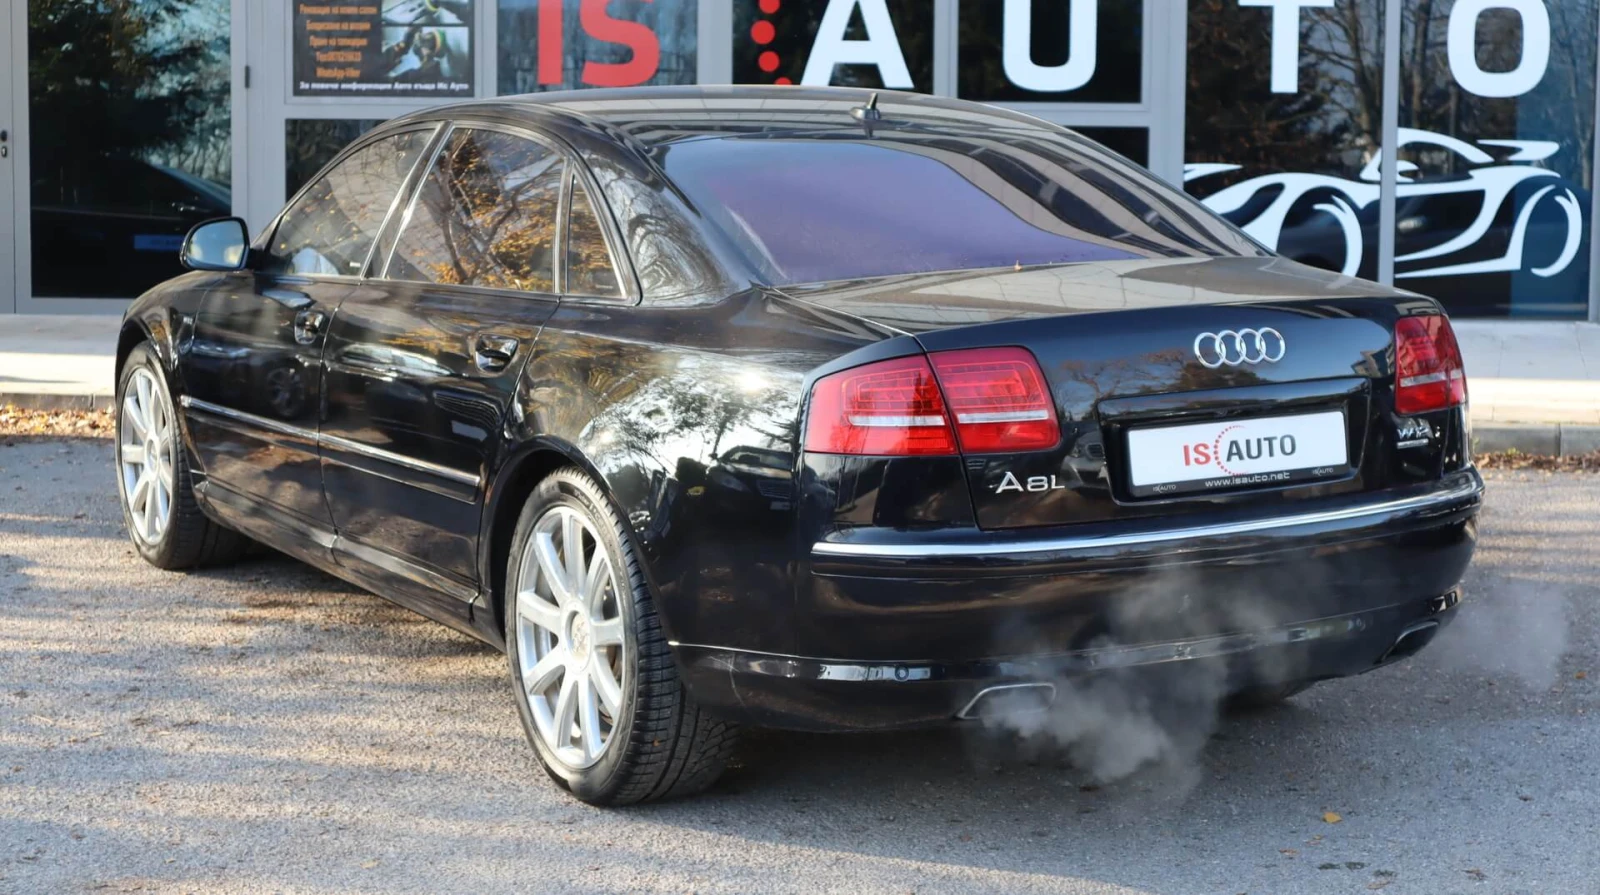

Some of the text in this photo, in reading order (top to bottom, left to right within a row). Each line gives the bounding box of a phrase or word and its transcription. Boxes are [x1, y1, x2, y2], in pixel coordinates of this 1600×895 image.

[537, 0, 1551, 97] IS AUTO
[1184, 435, 1296, 465] IS AUTO
[996, 471, 1065, 494] A8L
[1205, 472, 1290, 488] www.isauto.net
